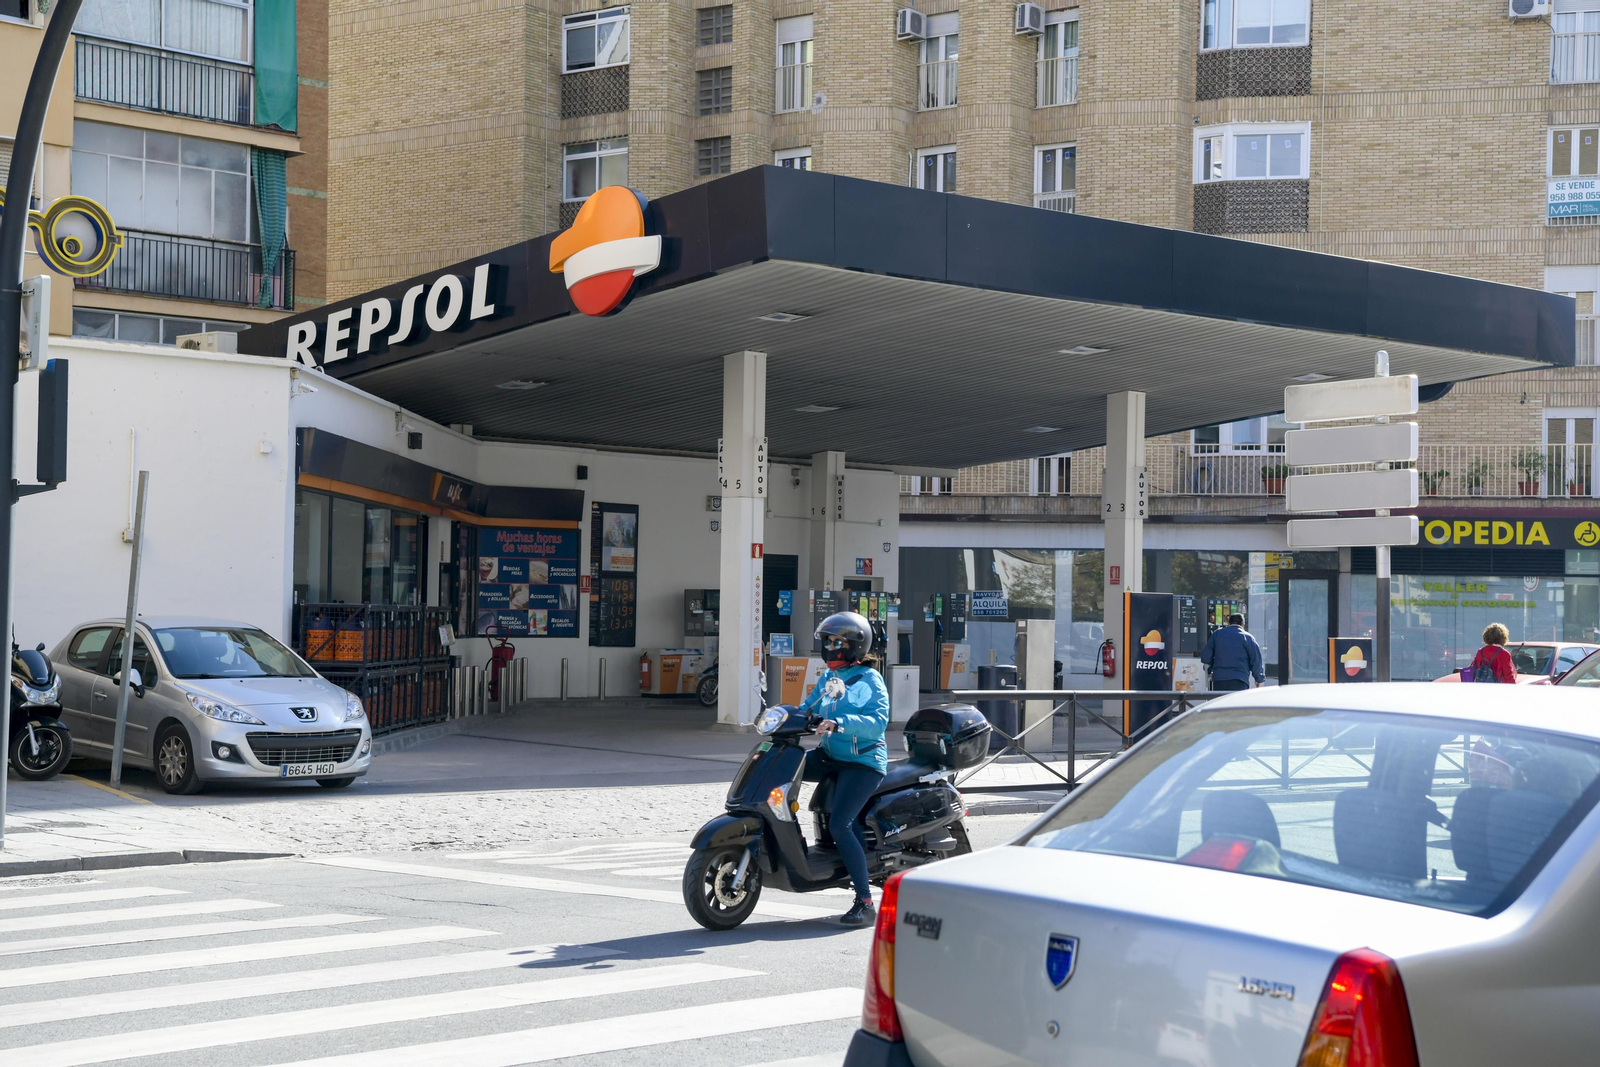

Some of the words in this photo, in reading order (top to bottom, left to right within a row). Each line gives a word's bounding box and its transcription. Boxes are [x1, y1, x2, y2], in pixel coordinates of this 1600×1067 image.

[1556, 182, 1566, 190] SE
[1568, 181, 1595, 190] VENDE
[1550, 193, 1566, 201] 958
[1568, 192, 1584, 200] 988
[1586, 192, 1600, 200] 055
[1551, 204, 1578, 214] MAR
[286, 263, 495, 366] REPSOL
[722, 479, 728, 489] 4
[736, 479, 741, 489] 5
[821, 507, 826, 515] 6
[1106, 503, 1111, 512] 2
[1120, 503, 1125, 512] 3
[496, 530, 534, 544] Muchas
[536, 532, 562, 544] horas
[1418, 520, 1550, 545] OPEDIA
[502, 543, 514, 552] de
[517, 543, 556, 556] ventajas
[1422, 582, 1487, 593] TALLER
[1462, 600, 1536, 608] ORTOPEDIA
[1136, 660, 1168, 670] REPSOL
[288, 765, 312, 775] 6645
[316, 764, 334, 774] HGD
